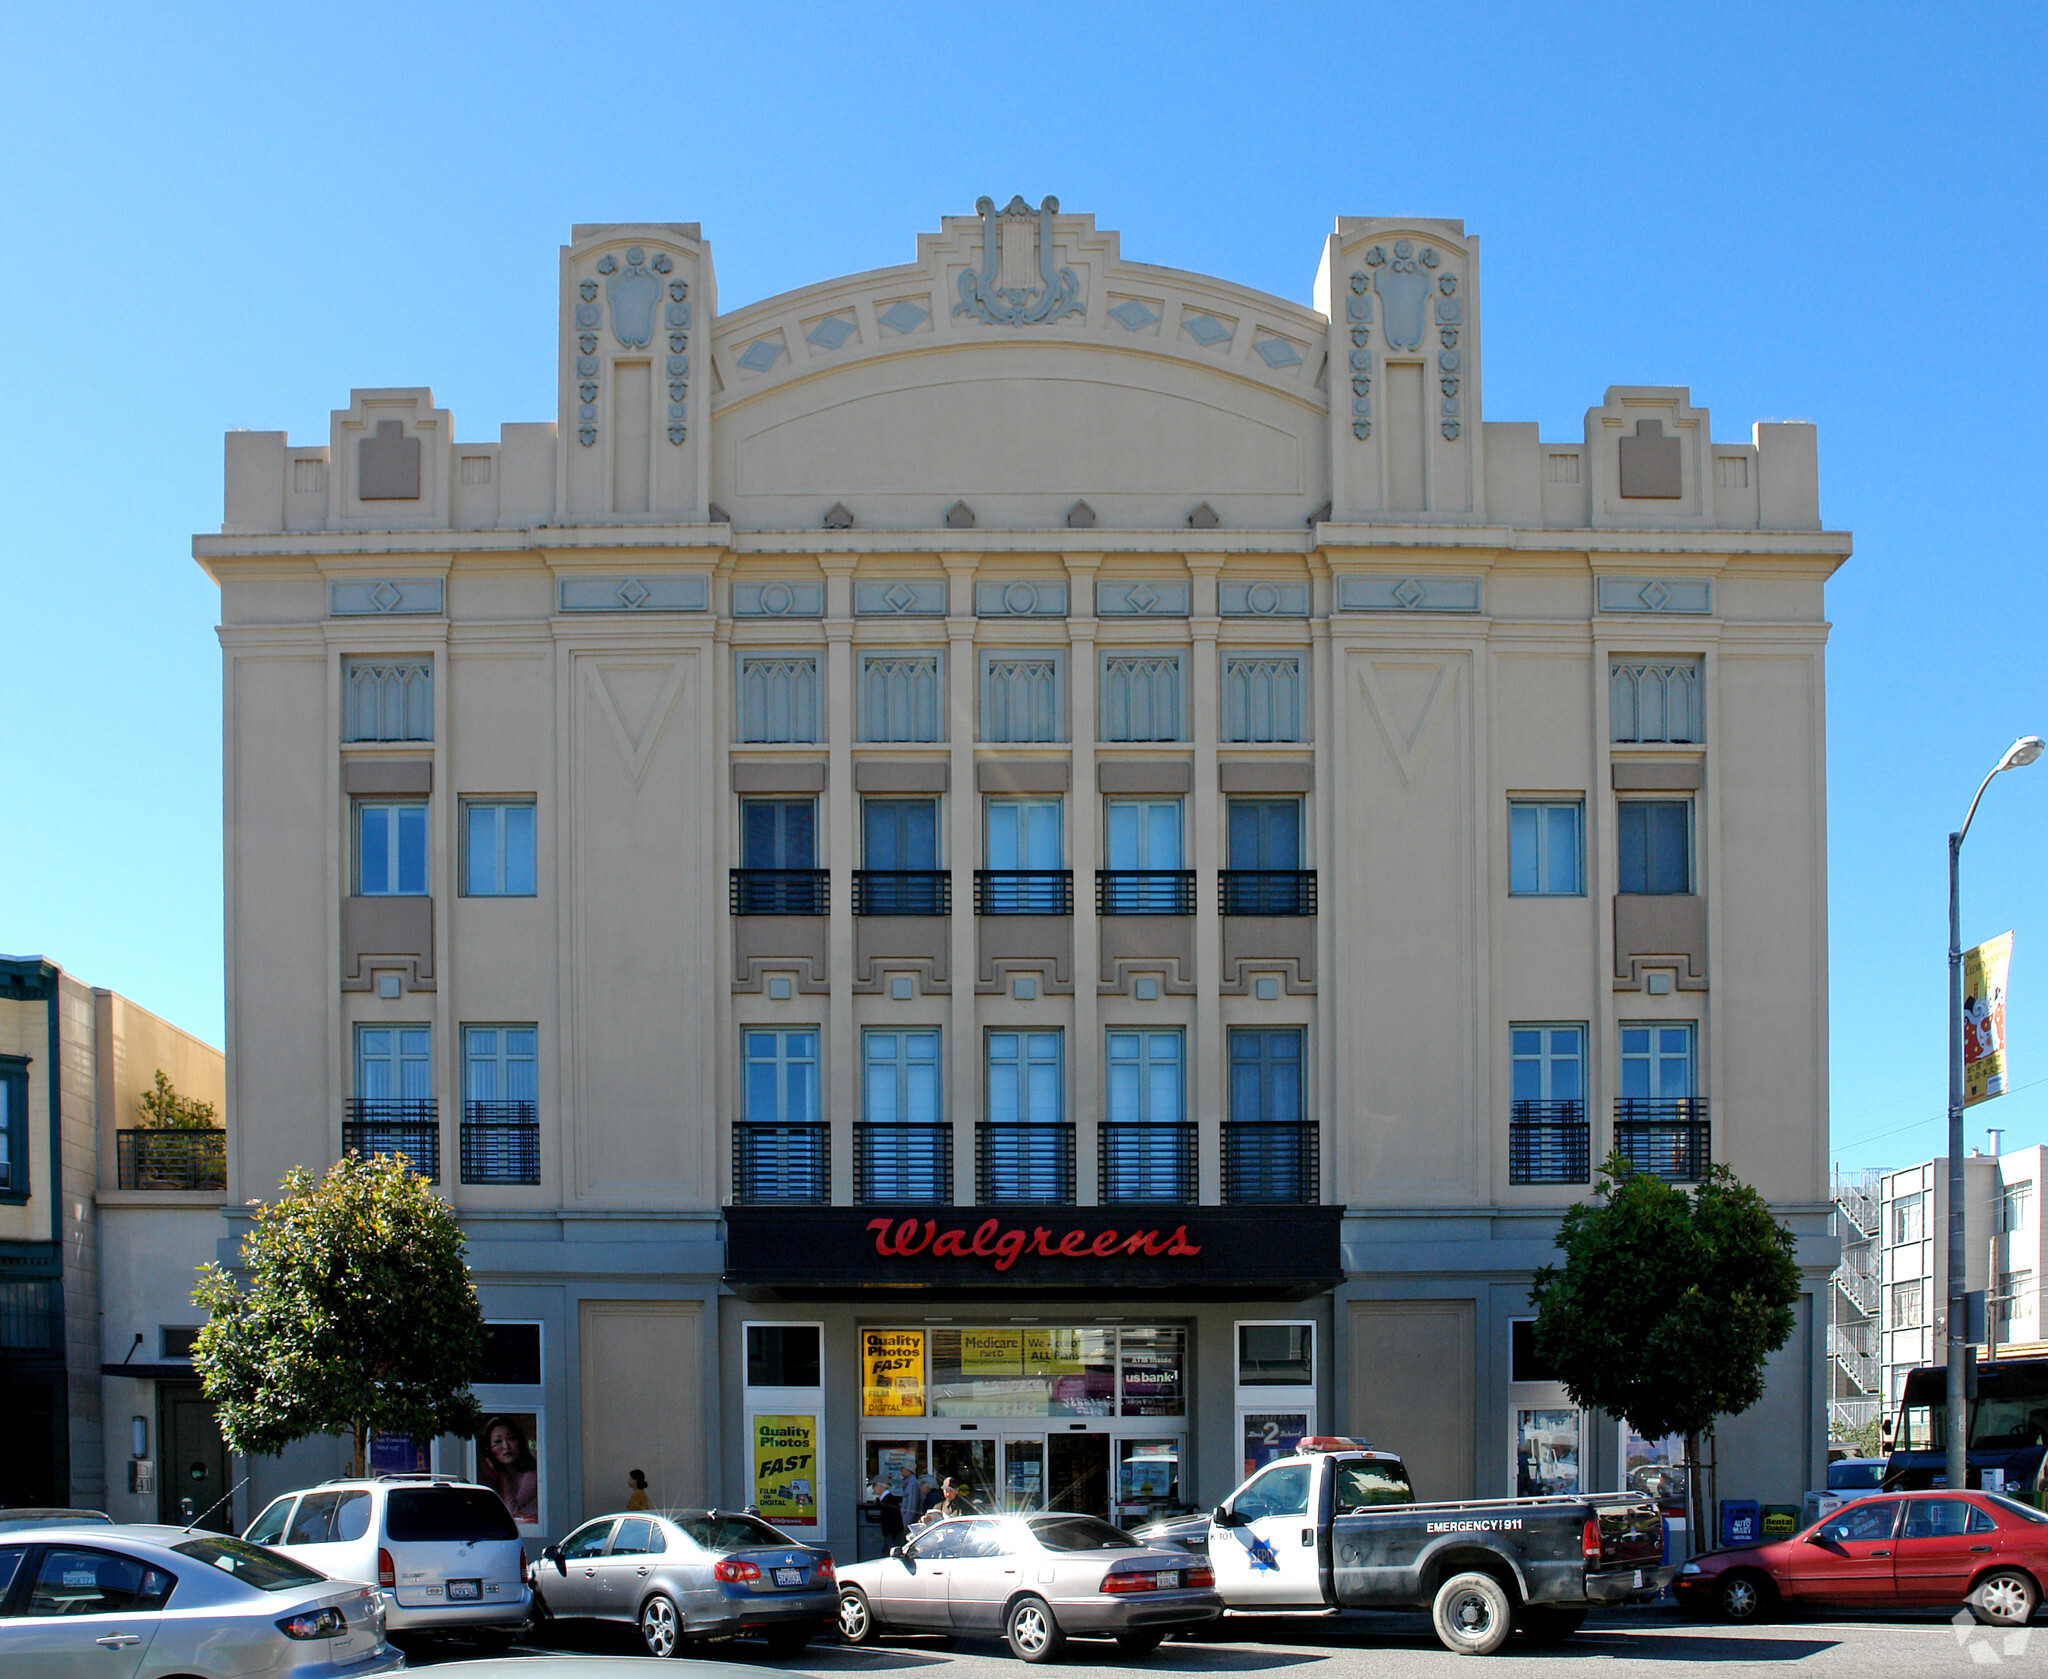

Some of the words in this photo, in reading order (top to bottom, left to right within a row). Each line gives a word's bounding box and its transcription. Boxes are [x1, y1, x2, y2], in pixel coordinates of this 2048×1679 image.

[866, 1218, 1202, 1271] Walgreens
[867, 1335, 920, 1348] Quality
[965, 1337, 1019, 1348] Medicare
[1028, 1338, 1045, 1348] We
[867, 1347, 920, 1357] Photos
[1030, 1351, 1052, 1360] ALL
[872, 1358, 914, 1374] FAST
[868, 1390, 889, 1398] FILM
[868, 1404, 901, 1412] DIGITAL
[759, 1426, 810, 1438] Quality
[1263, 1422, 1279, 1445] 2
[760, 1437, 810, 1448] Photos
[759, 1454, 812, 1479] FAST
[1426, 1519, 1498, 1533] EMERGENCY
[1504, 1519, 1523, 1530] 911
[1733, 1519, 1752, 1527] AUTO
[1219, 1532, 1232, 1540] 101
